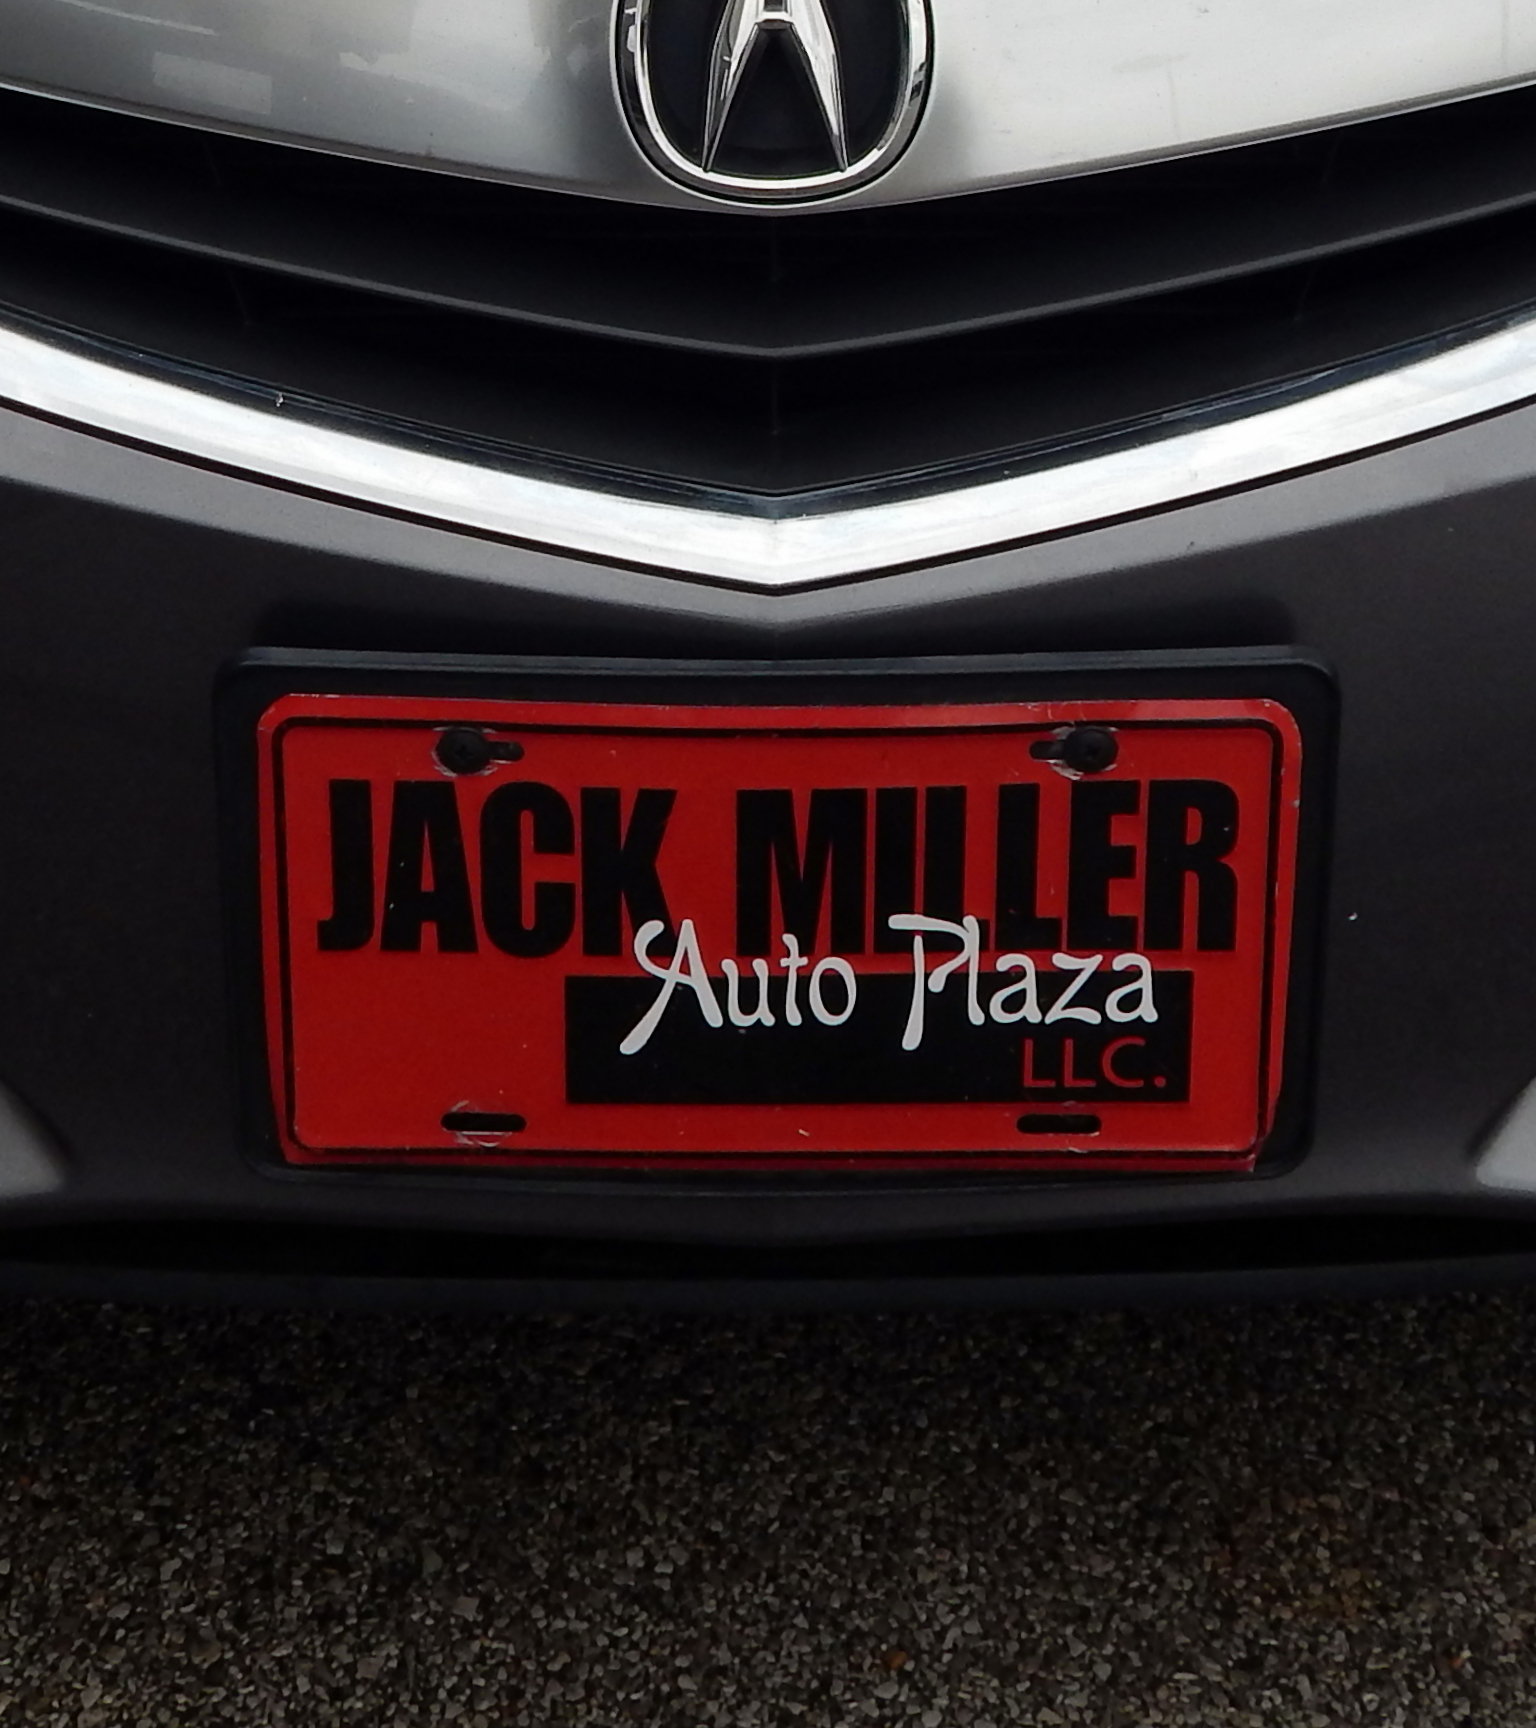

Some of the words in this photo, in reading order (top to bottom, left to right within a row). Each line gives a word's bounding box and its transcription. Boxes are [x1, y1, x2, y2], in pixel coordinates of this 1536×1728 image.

[318, 778, 677, 957] JACK
[735, 778, 1240, 956] MILLER
[619, 918, 857, 1055] Auto
[888, 913, 1160, 1051] Plaza
[1022, 1038, 1168, 1089] LLC.
